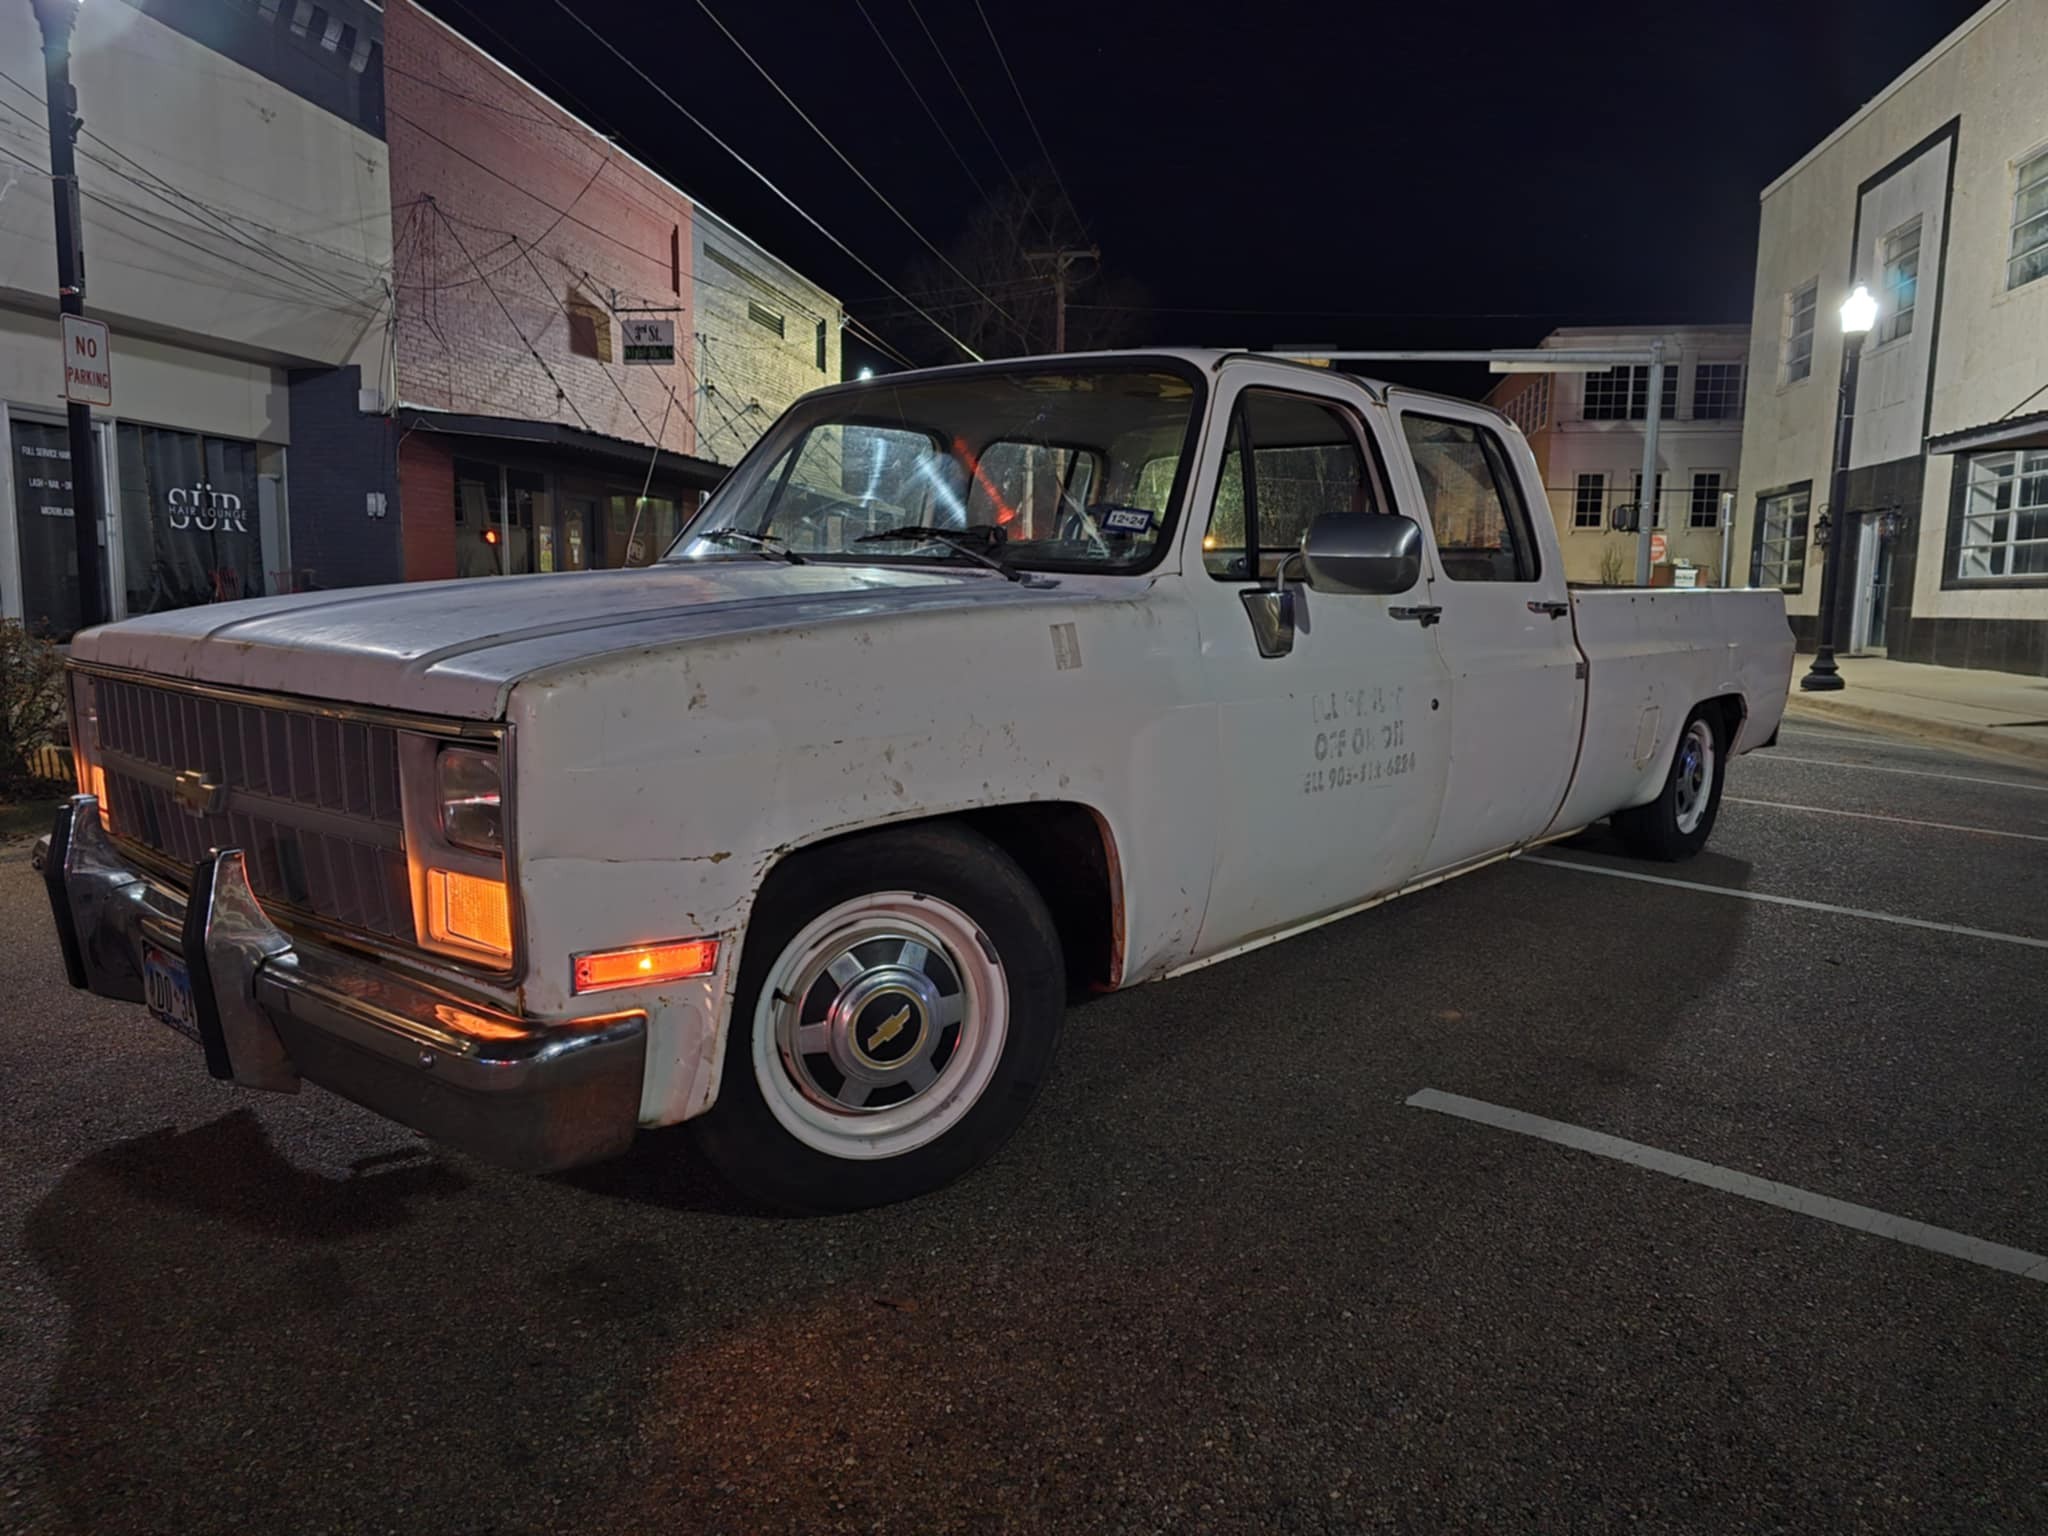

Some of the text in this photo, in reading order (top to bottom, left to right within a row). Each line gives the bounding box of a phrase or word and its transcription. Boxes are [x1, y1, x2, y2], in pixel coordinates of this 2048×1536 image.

[75, 335, 97, 358] NO
[67, 366, 109, 389] PARKING
[168, 482, 248, 532] SÜR
[169, 505, 248, 520] HAIR LOUNGE
